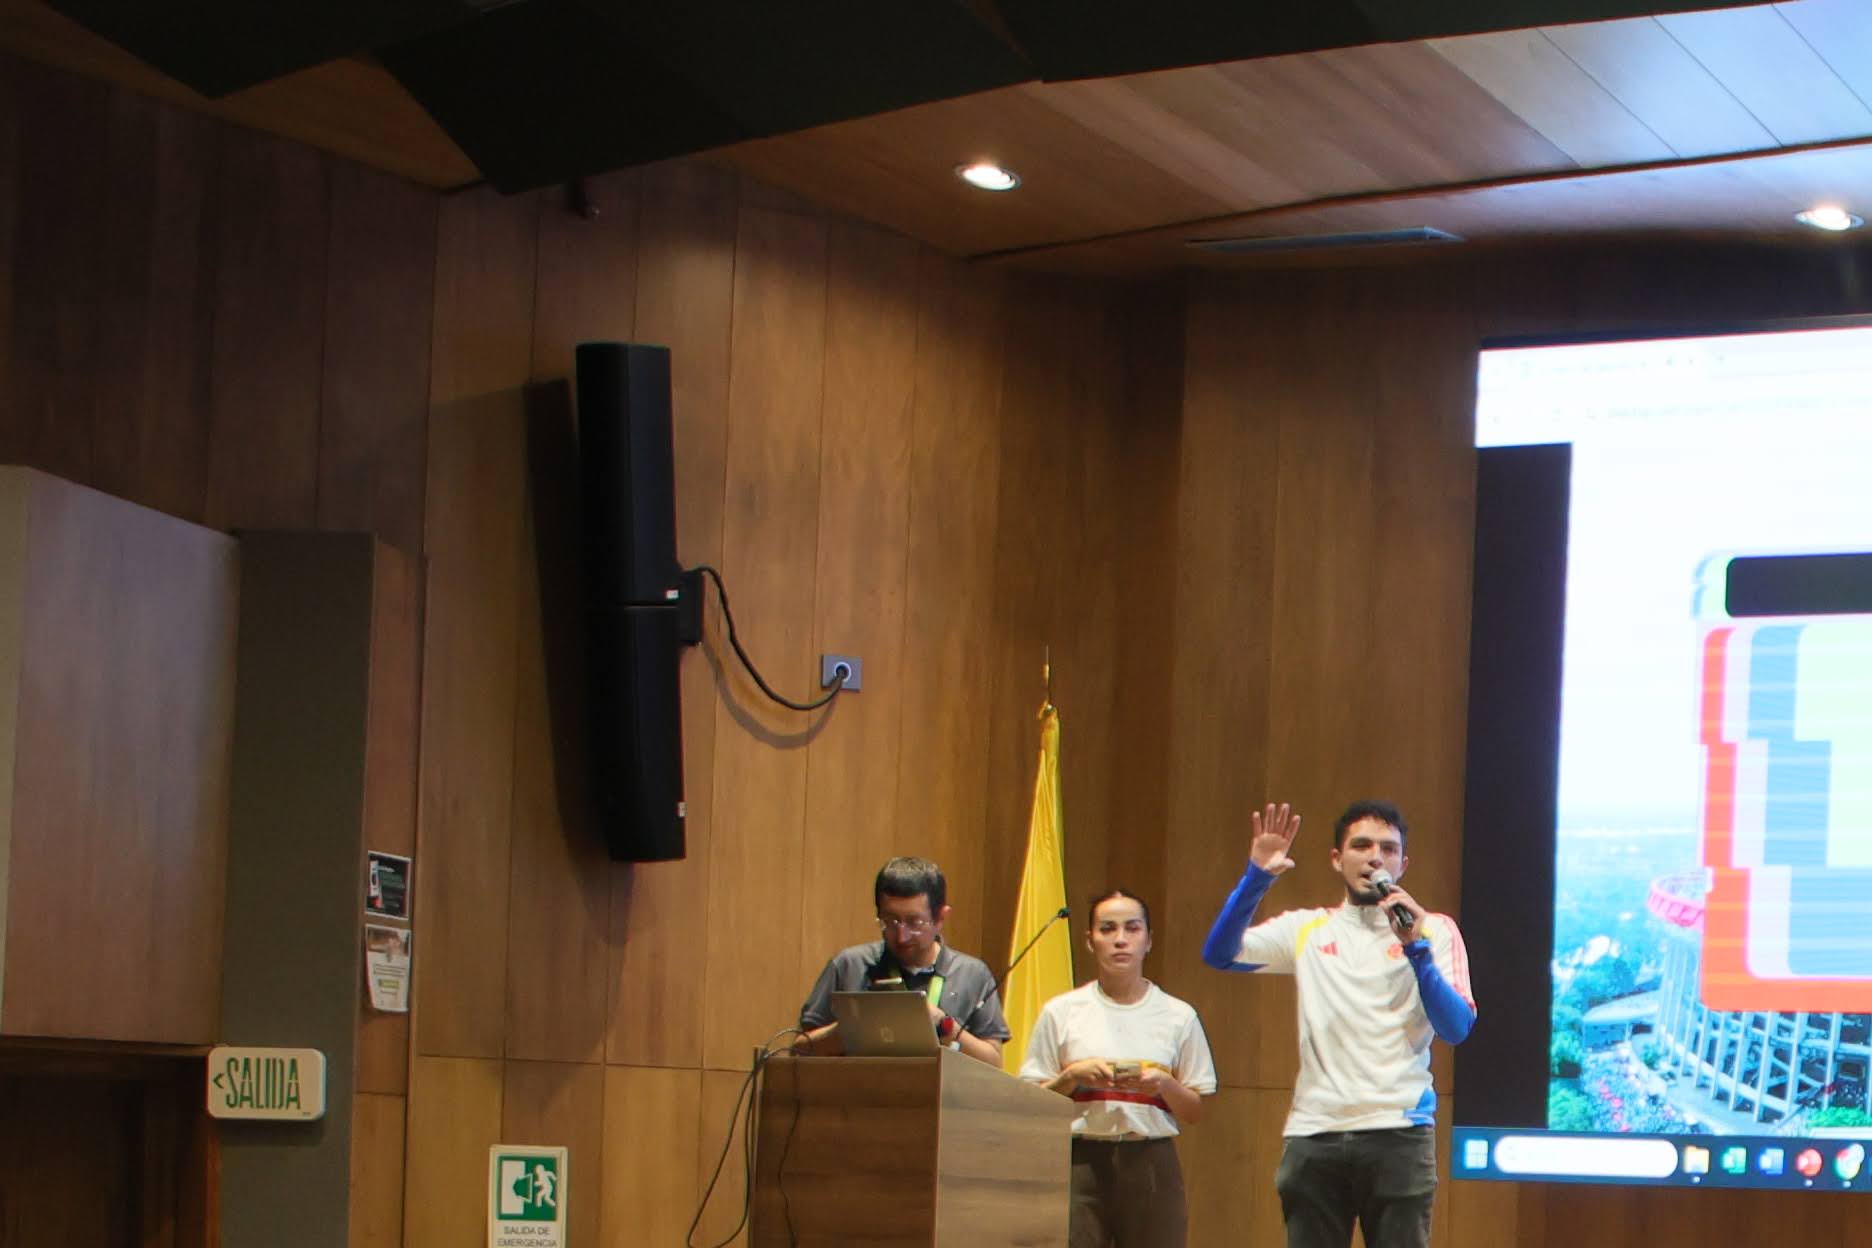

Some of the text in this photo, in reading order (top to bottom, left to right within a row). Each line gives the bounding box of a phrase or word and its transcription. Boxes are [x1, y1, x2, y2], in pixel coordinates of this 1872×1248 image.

[226, 1057, 301, 1110] SALIDA
[503, 1226, 552, 1236] SALIDA DE
[497, 1238, 558, 1248] EMERGENCIA
